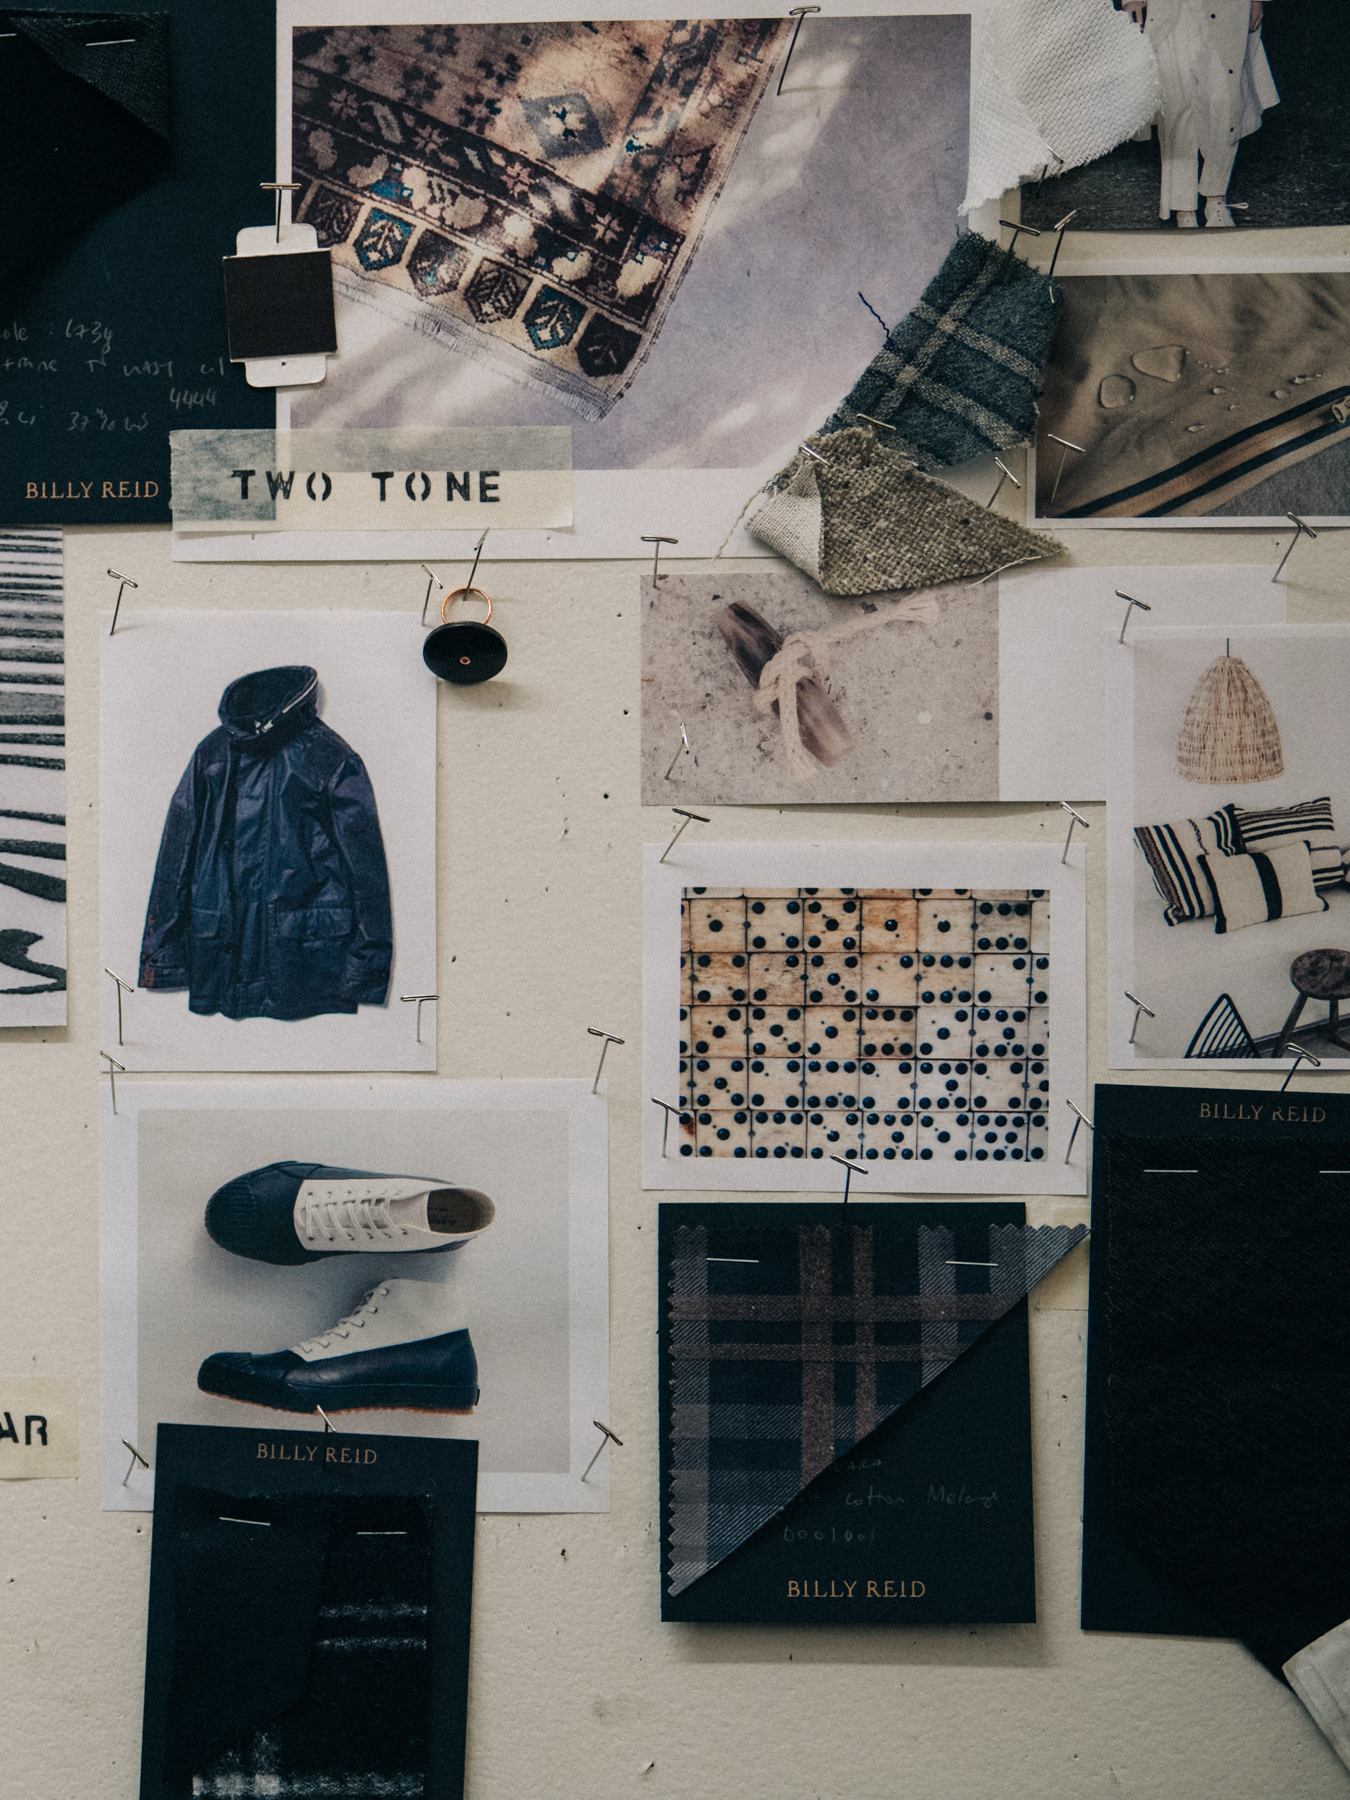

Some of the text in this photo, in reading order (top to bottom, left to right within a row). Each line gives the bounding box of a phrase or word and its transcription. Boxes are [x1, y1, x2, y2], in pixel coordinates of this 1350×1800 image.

[26, 481, 158, 498] BILLY REID
[231, 470, 499, 502] TWO TONE
[1200, 1103, 1325, 1122] BILLY REID
[257, 1443, 377, 1464] BILLY REID
[787, 1580, 925, 1597] BILLY REID
